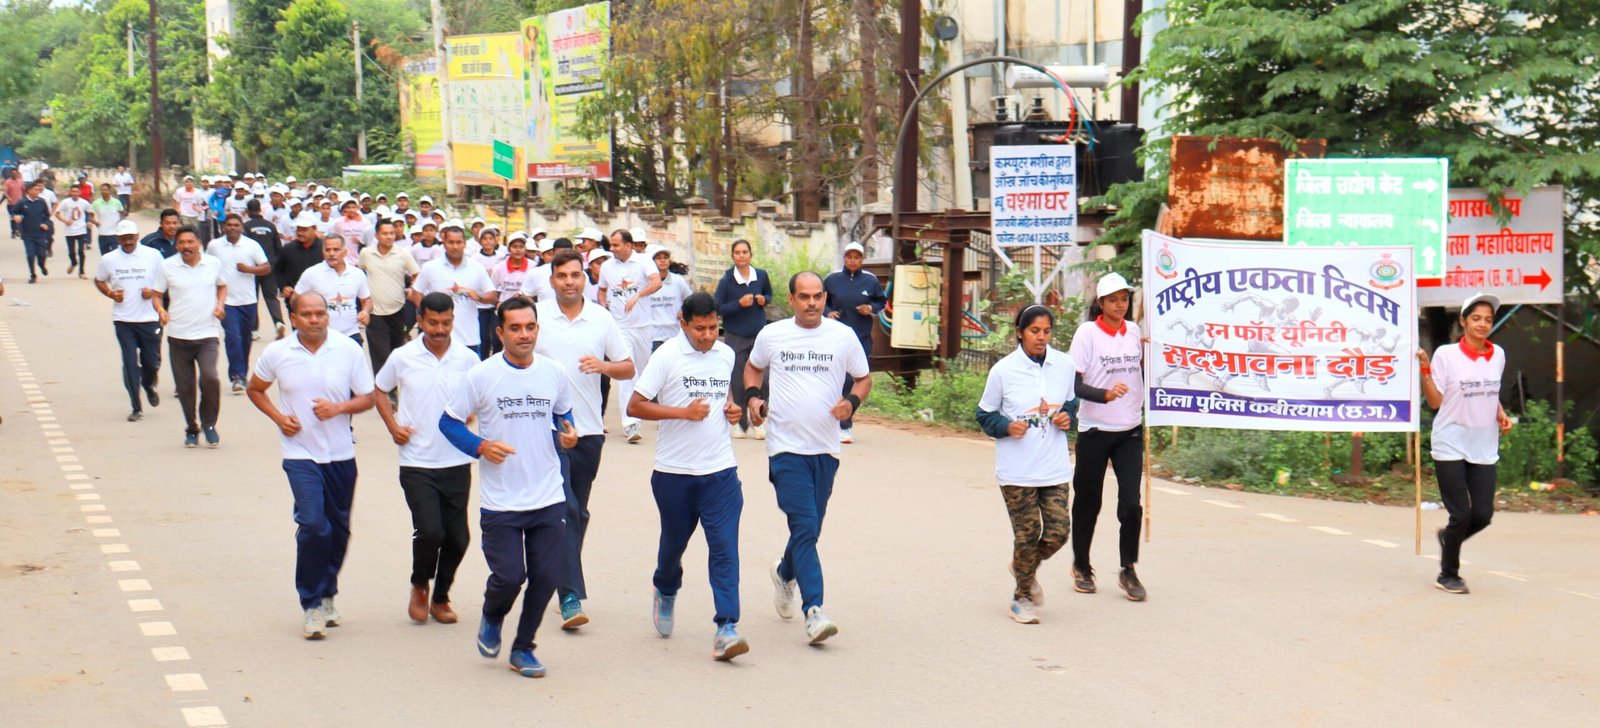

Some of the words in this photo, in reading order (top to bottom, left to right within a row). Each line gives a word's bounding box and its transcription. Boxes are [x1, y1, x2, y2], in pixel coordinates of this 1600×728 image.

[995, 157, 1027, 173] कम्प्यूटर
[1018, 170, 1038, 187] जाँच
[1296, 169, 1332, 194] जिला
[1336, 171, 1375, 195] उद्योग
[1044, 191, 1069, 210] घर
[1296, 206, 1332, 229] जिला
[1338, 212, 1393, 229] न्यायालय
[1447, 235, 1470, 256] त्सा
[1476, 228, 1554, 255] महाविद्यालय
[1445, 265, 1484, 288] कबीरधाम
[1156, 267, 1223, 315] राष्ट्रीय
[1226, 267, 1317, 295] एकता
[1321, 264, 1401, 326] दिवस
[1205, 322, 1229, 339] रन
[1233, 321, 1276, 341] फॉर
[1281, 320, 1349, 347] यूनिटी
[780, 351, 805, 363] ट्रैफिक
[808, 350, 833, 362] मितान
[1163, 343, 1319, 379] सद्भावना
[1325, 347, 1398, 385] दौड़
[812, 364, 829, 373] पुलिस
[682, 376, 707, 390] ट्रैफिक
[496, 396, 523, 410] ट्रैफिक
[526, 395, 551, 407] मितान
[1155, 388, 1192, 409] जिला
[1196, 392, 1247, 414] पुलिस
[1249, 399, 1334, 419] कबीरधाम
